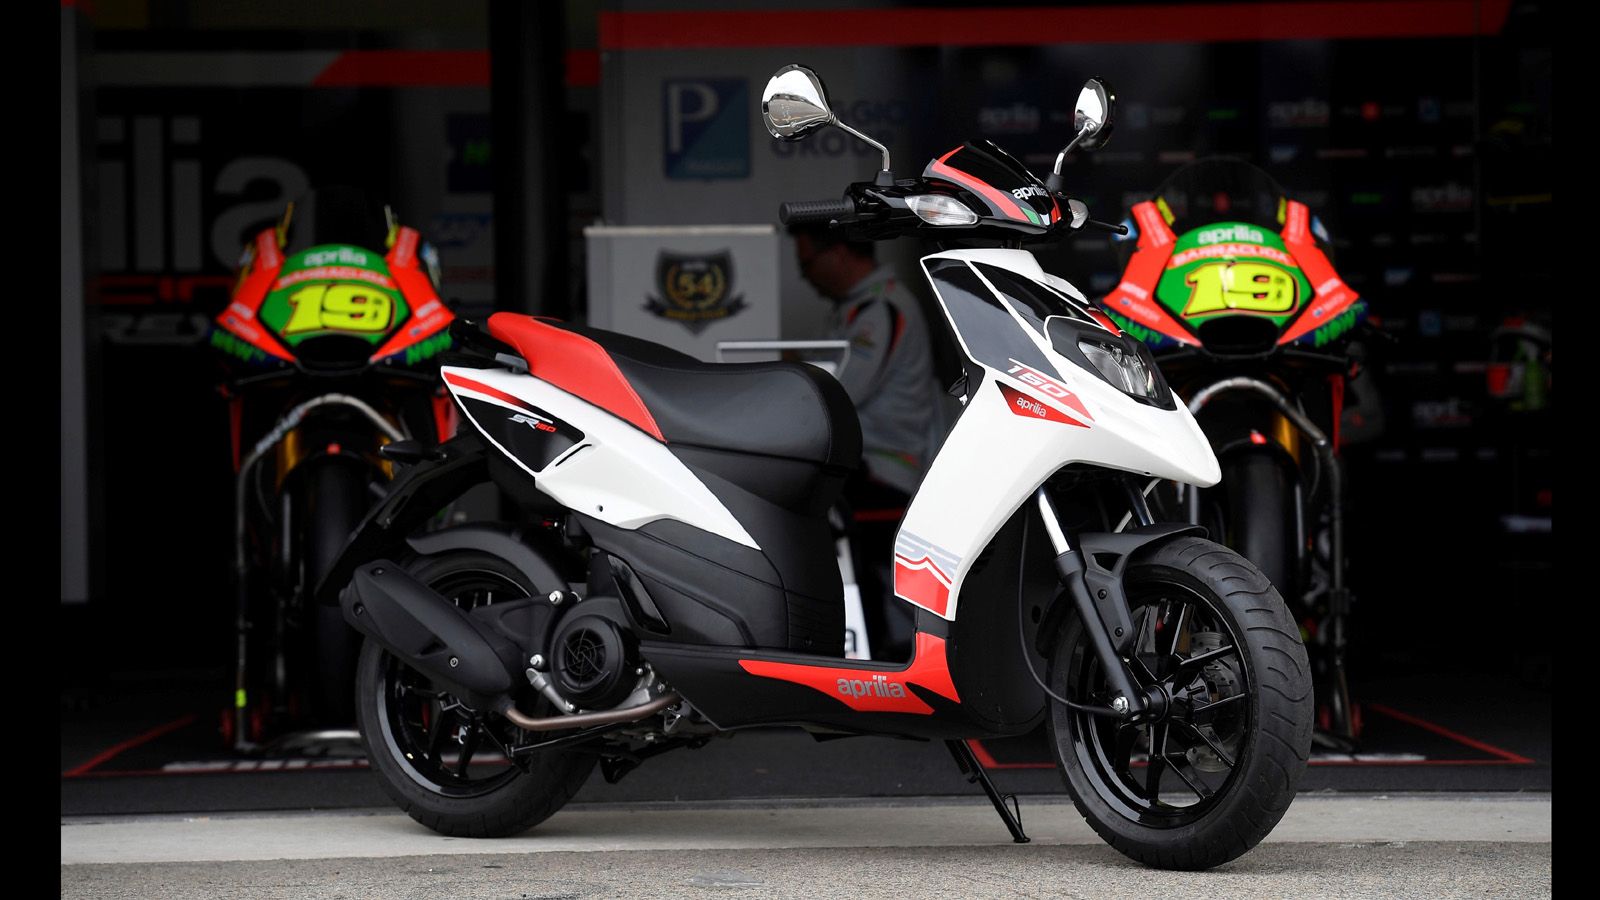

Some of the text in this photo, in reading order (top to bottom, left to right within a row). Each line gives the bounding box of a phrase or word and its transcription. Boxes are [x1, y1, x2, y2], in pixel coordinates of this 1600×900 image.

[1198, 225, 1264, 245] aprilia
[304, 247, 368, 267] aprilia
[1182, 261, 1298, 318] 19
[283, 282, 396, 335] 19
[1016, 396, 1048, 418] aprilia
[836, 674, 907, 699] aprilia
